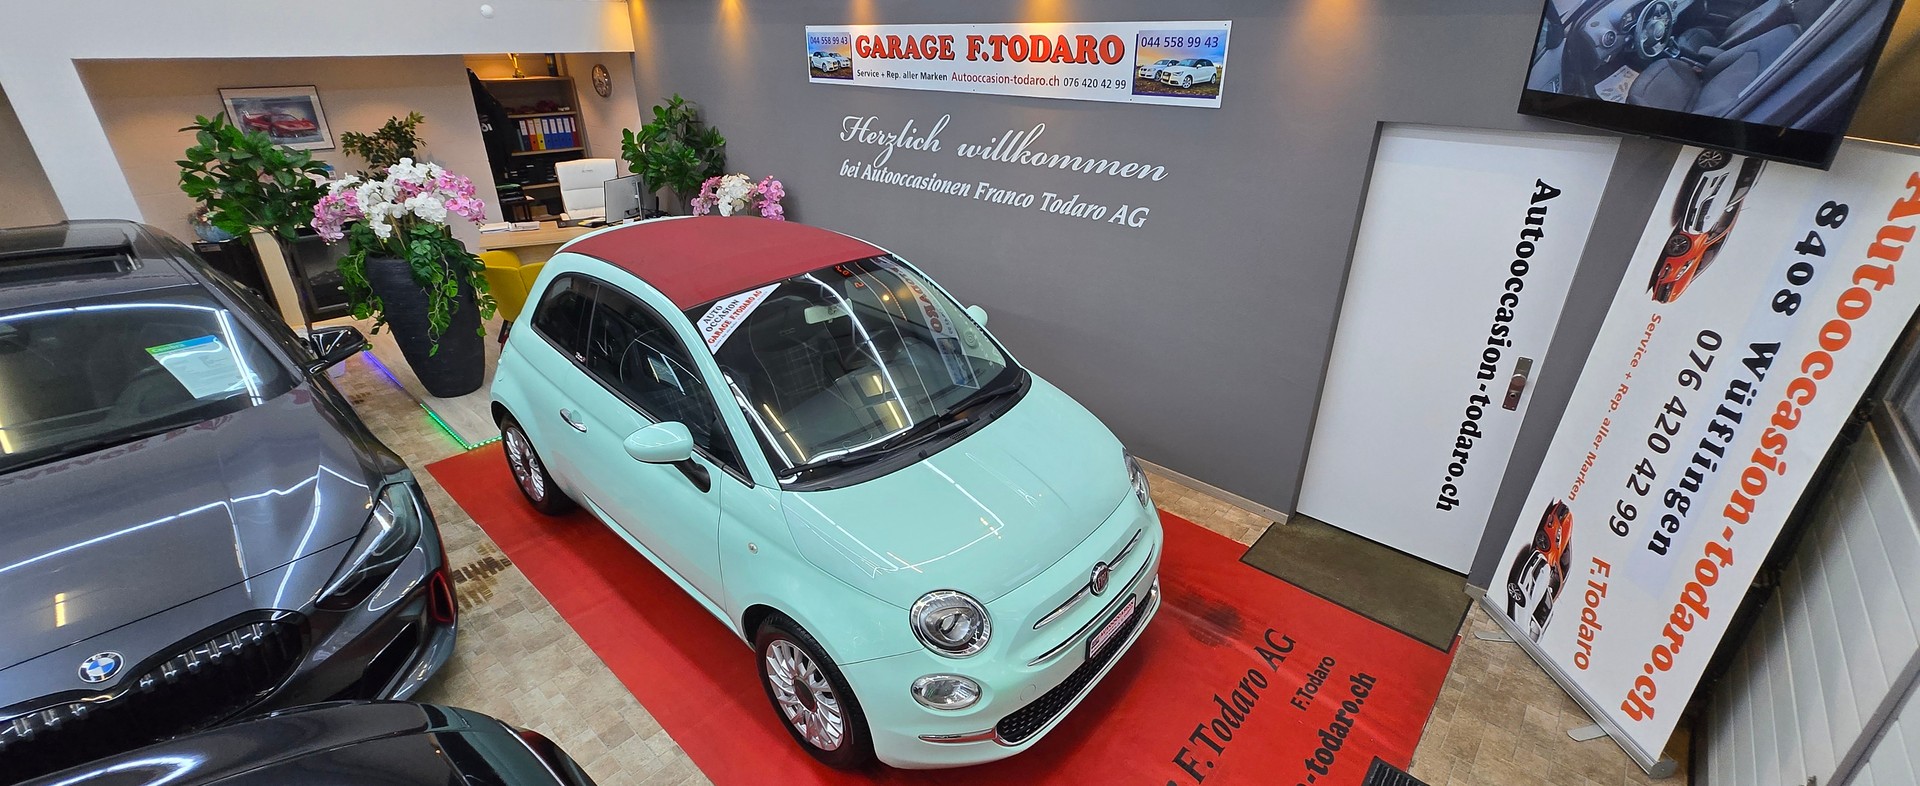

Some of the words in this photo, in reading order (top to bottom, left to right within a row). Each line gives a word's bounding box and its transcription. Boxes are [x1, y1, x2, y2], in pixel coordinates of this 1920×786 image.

[810, 36, 820, 45] 044
[821, 36, 831, 45] 558
[832, 36, 840, 45] 99
[841, 36, 848, 45] 43
[855, 34, 955, 61] GARAGE
[966, 34, 1125, 64] F.TODARO
[1141, 36, 1161, 48] 044
[1164, 36, 1184, 48] 558
[1187, 36, 1201, 48] 99
[1204, 36, 1219, 48] 43
[857, 70, 879, 78] Service
[886, 70, 901, 80] Rep.
[902, 71, 918, 79] aller
[920, 72, 948, 81] Marken
[951, 72, 1060, 87] Autooccasion-todaro.ch
[1063, 77, 1079, 88] 076
[1081, 78, 1098, 88] 420
[1100, 79, 1112, 89] 42
[1115, 79, 1127, 90] 99
[840, 114, 951, 169] Herzlich
[957, 123, 1169, 182] willkommen
[840, 159, 860, 179] bei
[861, 165, 971, 198] Autooccasionen
[974, 182, 1034, 208] Franco
[1040, 192, 1109, 222] Todaro
[1109, 205, 1150, 229] AG
[1771, 200, 1850, 317] 8408
[703, 305, 723, 324] AUTO
[705, 299, 740, 332] OCCASION
[708, 319, 732, 344] GARAGE
[729, 296, 756, 320] F.TODARO
[1436, 178, 1562, 512] Autooccasion-todaro.ch
[1630, 313, 1662, 368] Service
[1679, 329, 1723, 392] 076
[1608, 383, 1629, 413] Rep.
[1593, 417, 1611, 450] aller
[1647, 395, 1689, 455] 420
[1647, 341, 1782, 556] Wülflingen
[1568, 451, 1597, 501] Marken
[1626, 457, 1657, 497] 42
[1608, 499, 1639, 538] 99
[1573, 556, 1611, 671] F.Todaro
[1172, 669, 1269, 785] F.Todaro
[1255, 628, 1297, 673] AG
[1290, 656, 1336, 711] F.Todaro
[1296, 672, 1377, 786] -todaro.ch
